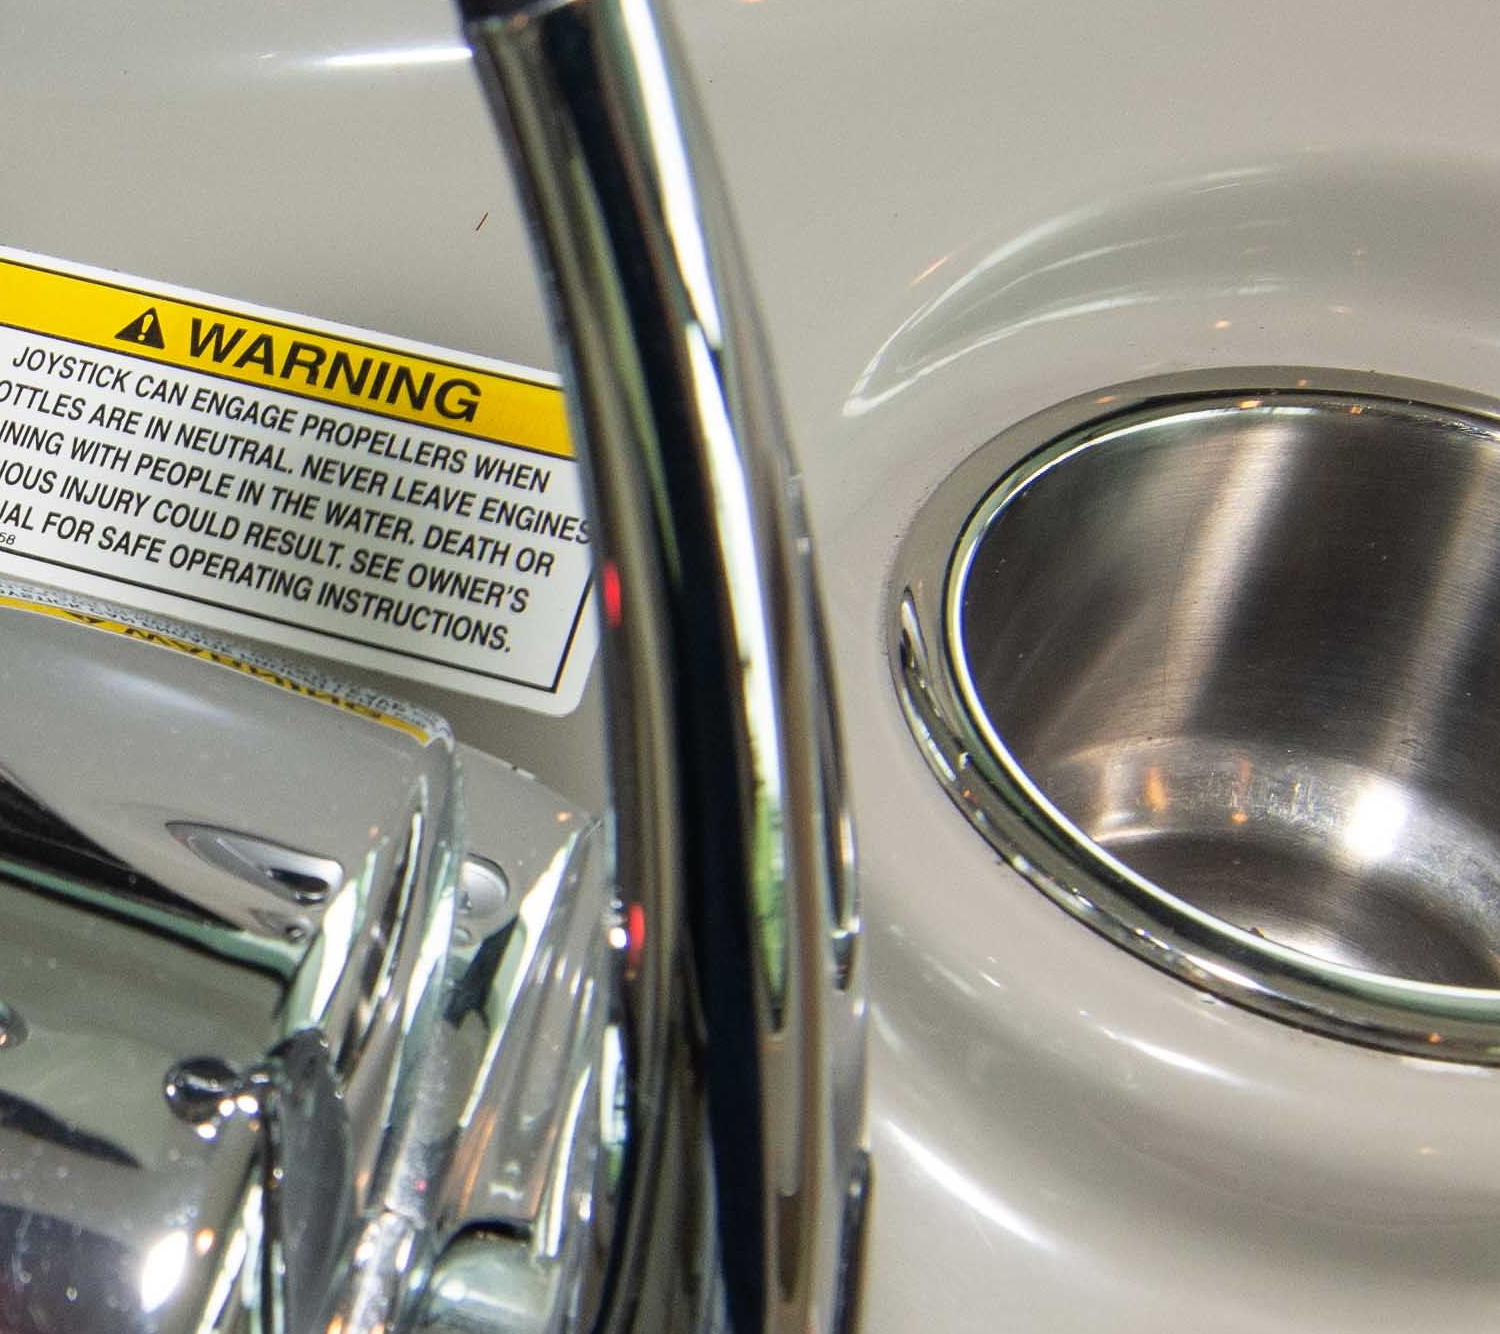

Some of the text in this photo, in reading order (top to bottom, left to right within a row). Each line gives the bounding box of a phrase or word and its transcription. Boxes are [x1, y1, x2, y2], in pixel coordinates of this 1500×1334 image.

[11, 346, 551, 494] JOYSTICK CAN ENGAGE PROPELLERS WHEN
[189, 317, 482, 423] WARNING
[59, 475, 153, 518] INJURY
[152, 498, 241, 541] COULD
[242, 521, 346, 569] RESULT.
[349, 548, 404, 584] SEE
[407, 562, 530, 614] OWNER'S
[70, 436, 133, 473] WITH
[133, 452, 236, 499] PEOPLE
[235, 478, 266, 507] IN
[270, 485, 321, 521] THE
[324, 499, 414, 546] WATER.
[422, 524, 512, 567] DEATH
[515, 546, 555, 578] OR
[87, 403, 144, 436] ARE
[143, 415, 174, 443] IN
[173, 422, 293, 475] NEUTRAL.
[300, 453, 389, 497] NEVER
[390, 476, 477, 518] LEAVE
[478, 496, 588, 545] ENGINES
[40, 511, 95, 545] FOR
[97, 525, 167, 564] SAFE
[169, 543, 314, 602] OPERATING
[316, 581, 511, 653] INSTRUCTIONS.
